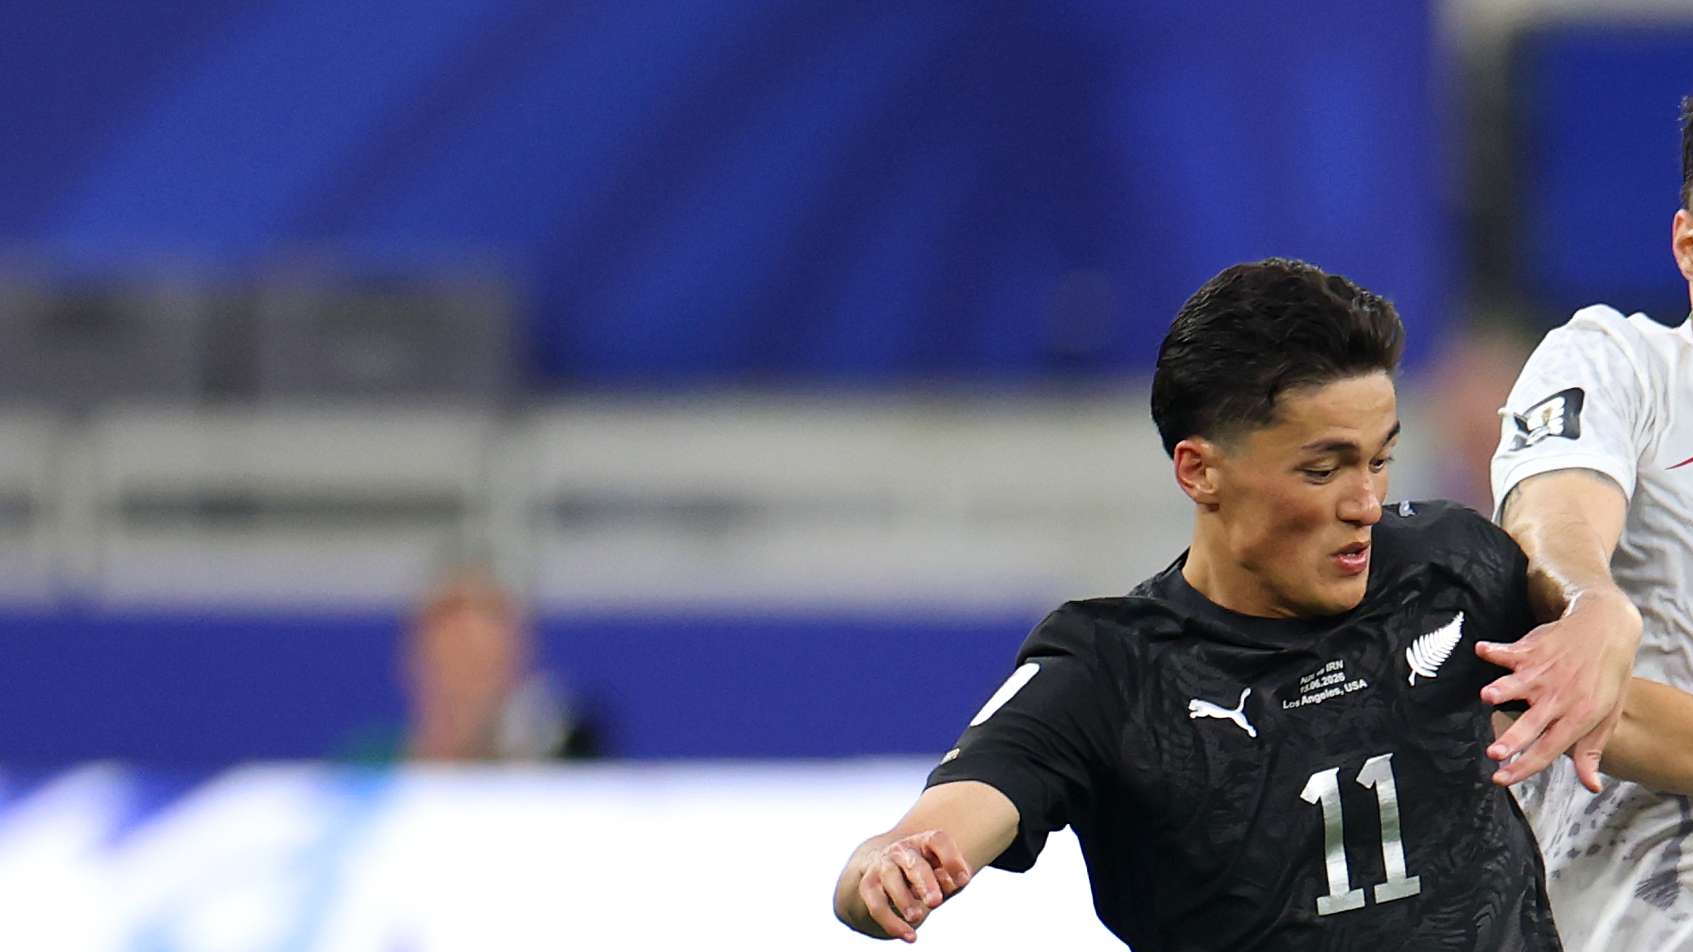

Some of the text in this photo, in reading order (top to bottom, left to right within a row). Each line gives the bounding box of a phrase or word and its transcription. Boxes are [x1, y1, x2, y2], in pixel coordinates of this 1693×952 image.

[1326, 659, 1344, 673] IRN
[1282, 678, 1369, 709] Los Angeles, USA
[1299, 752, 1421, 917] 11
